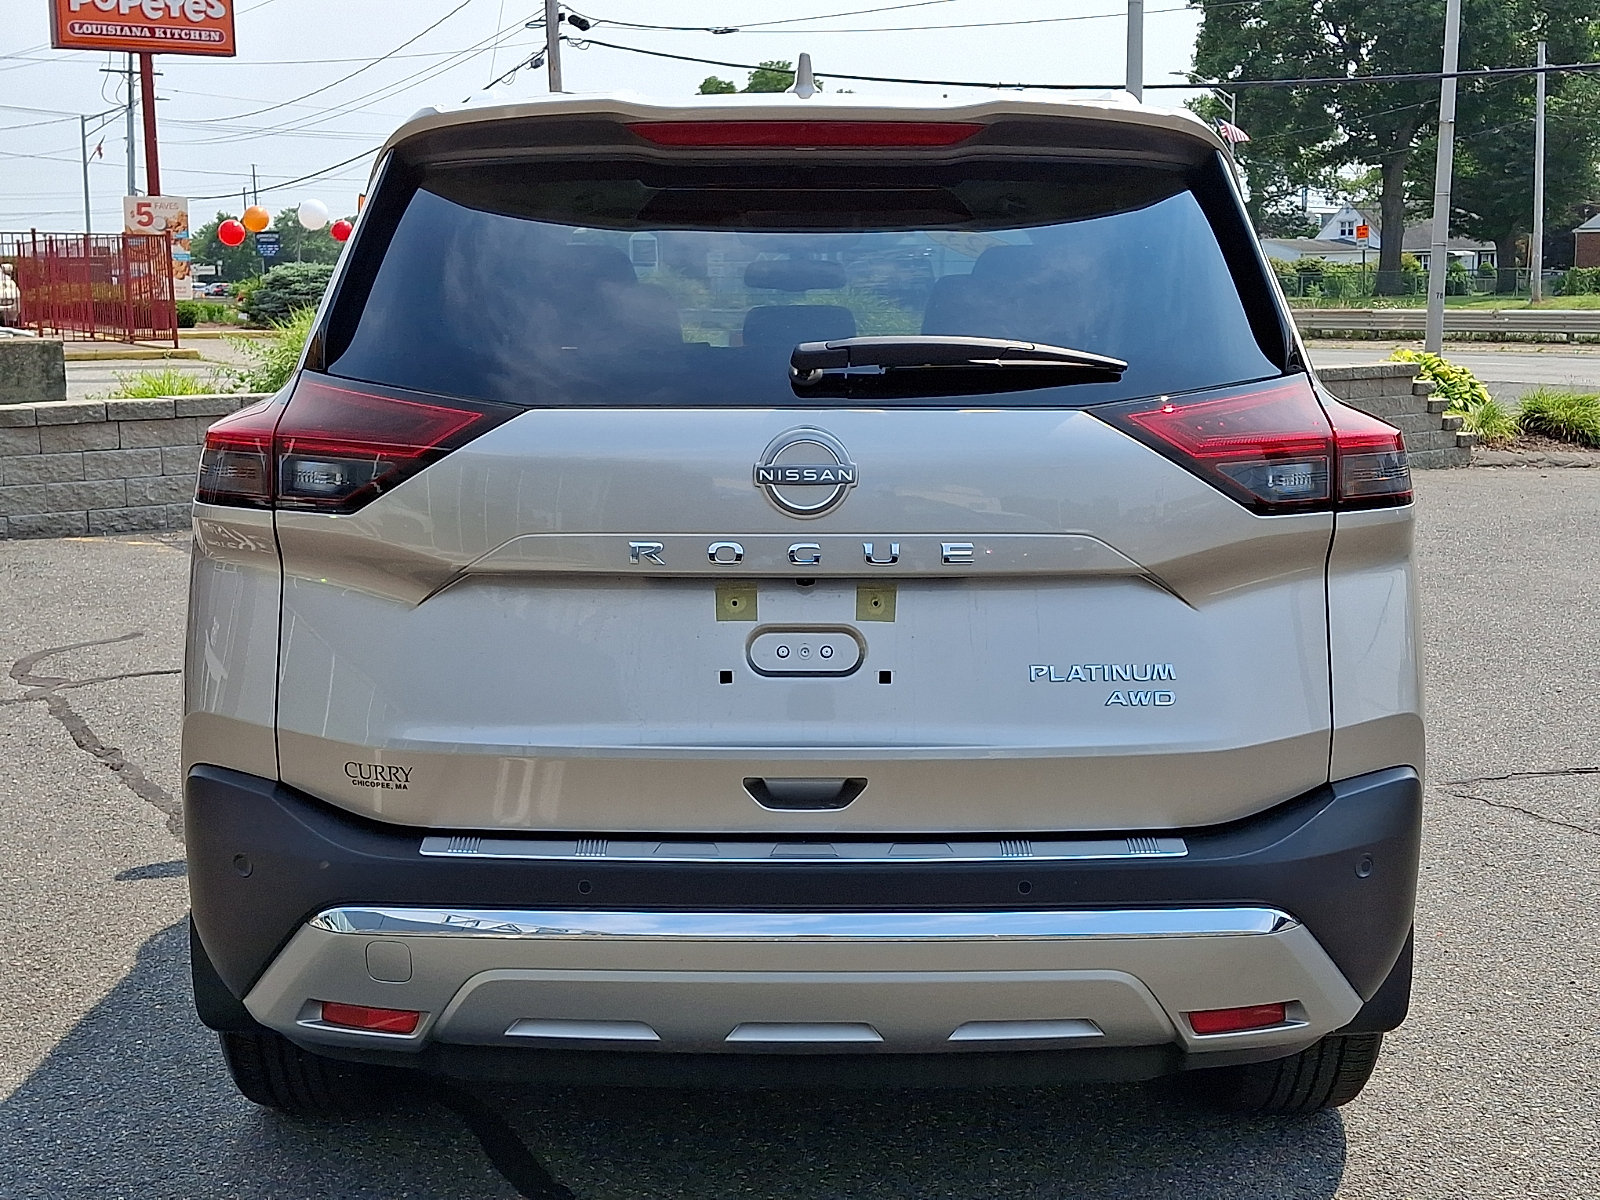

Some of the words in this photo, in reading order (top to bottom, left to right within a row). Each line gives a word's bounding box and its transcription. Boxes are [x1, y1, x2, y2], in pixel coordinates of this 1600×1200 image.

[73, 23, 151, 37] LOUISIANA
[155, 27, 220, 41] KITCHEN
[154, 202, 180, 210] FAVES
[758, 468, 854, 482] NISSAN
[628, 541, 975, 566] ROGUE
[1028, 663, 1177, 682] PLATINUM
[1104, 689, 1177, 706] AWD
[344, 761, 413, 783] CURRY
[352, 779, 394, 790] CHICOPEE,
